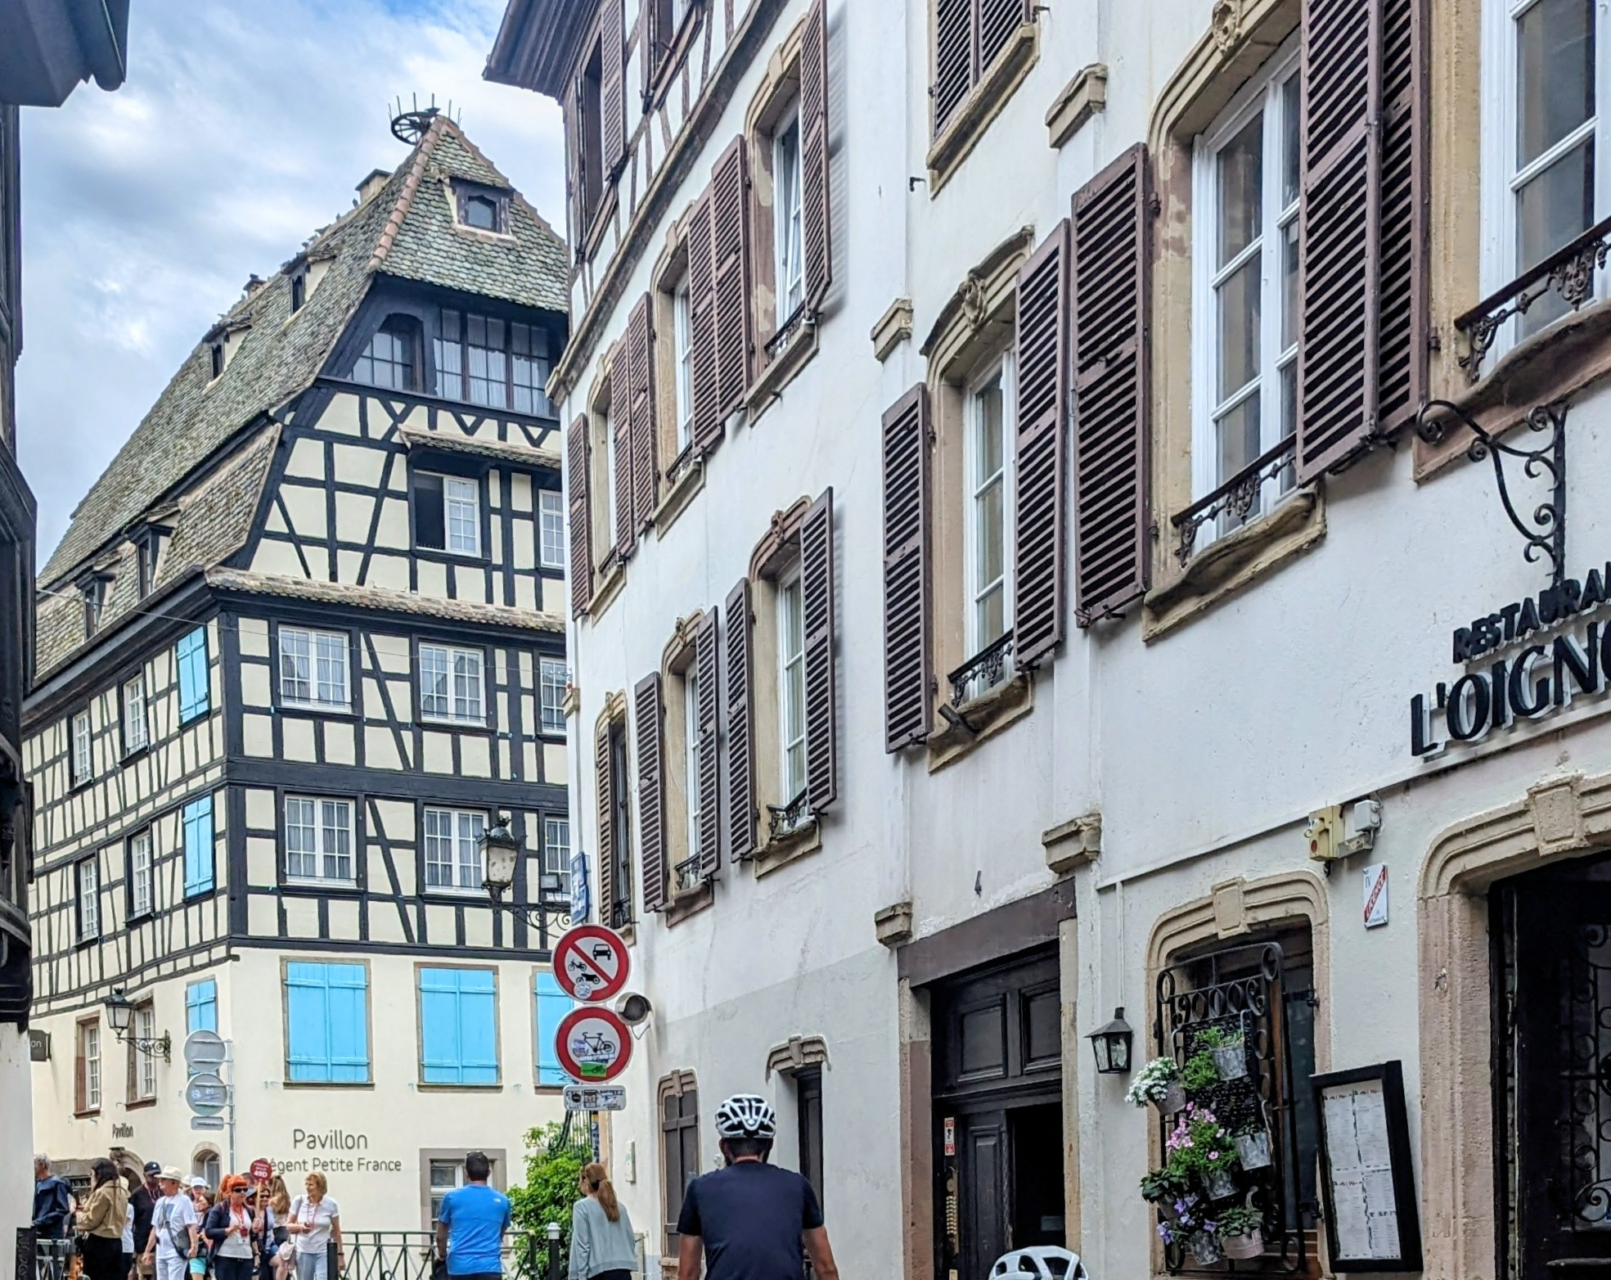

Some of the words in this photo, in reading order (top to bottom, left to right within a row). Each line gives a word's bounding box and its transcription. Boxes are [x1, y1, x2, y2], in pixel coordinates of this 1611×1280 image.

[1453, 561, 1611, 664] RESTAURA
[1410, 621, 1611, 757] L'OIGN
[266, 1157, 308, 1175] égent
[312, 1157, 353, 1172] Petite
[357, 1157, 402, 1172] France
[293, 1129, 368, 1149] Pavillon
